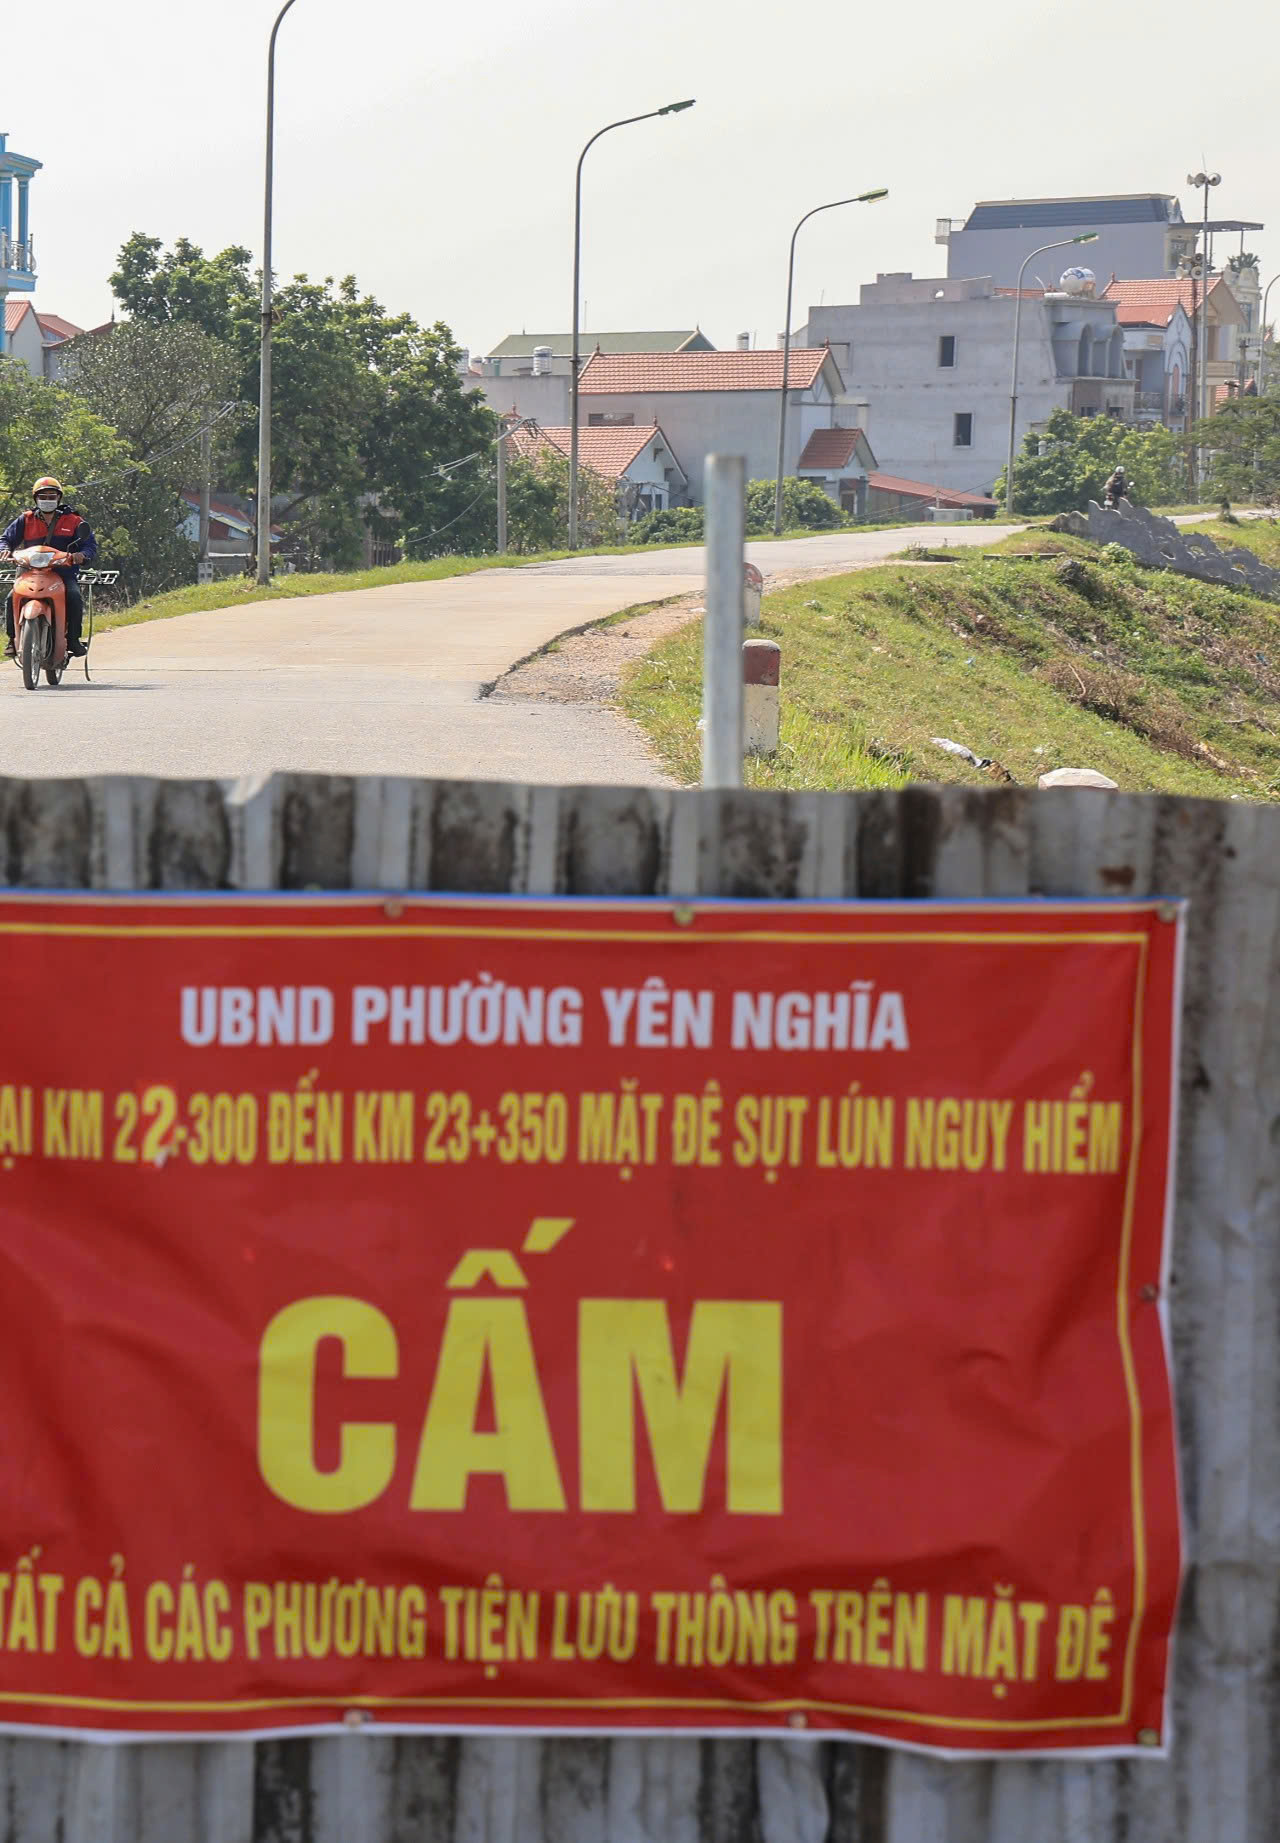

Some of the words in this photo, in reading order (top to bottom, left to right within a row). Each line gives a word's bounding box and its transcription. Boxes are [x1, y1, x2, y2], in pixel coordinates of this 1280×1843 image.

[180, 985, 334, 1047] UBND
[351, 972, 583, 1046] PHƯỜNG
[602, 976, 714, 1049] YÊN
[731, 981, 909, 1051] NGHĨA
[44, 1089, 103, 1161] KM
[267, 1069, 343, 1164] ĐẾN
[353, 1091, 414, 1163] KM
[423, 1091, 568, 1164] 23+350
[578, 1080, 664, 1180] MẶT
[671, 1082, 723, 1166] ĐÊ
[733, 1095, 809, 1183] SỤT
[817, 1082, 894, 1169] LÚN
[904, 1097, 1013, 1172] NGUY
[1023, 1071, 1121, 1174] HIỂM
[257, 1217, 784, 1515] CẤM
[75, 1554, 132, 1659] CẢ
[145, 1564, 233, 1661] CÁC
[244, 1576, 426, 1660] PHƯƠNG
[440, 1574, 539, 1677] TIỆN
[552, 1582, 639, 1661] LƯU
[651, 1574, 797, 1665] THÔNG
[810, 1578, 927, 1671] TRÊN
[941, 1583, 1047, 1698] MẶT
[1056, 1588, 1115, 1681] ĐÊ
